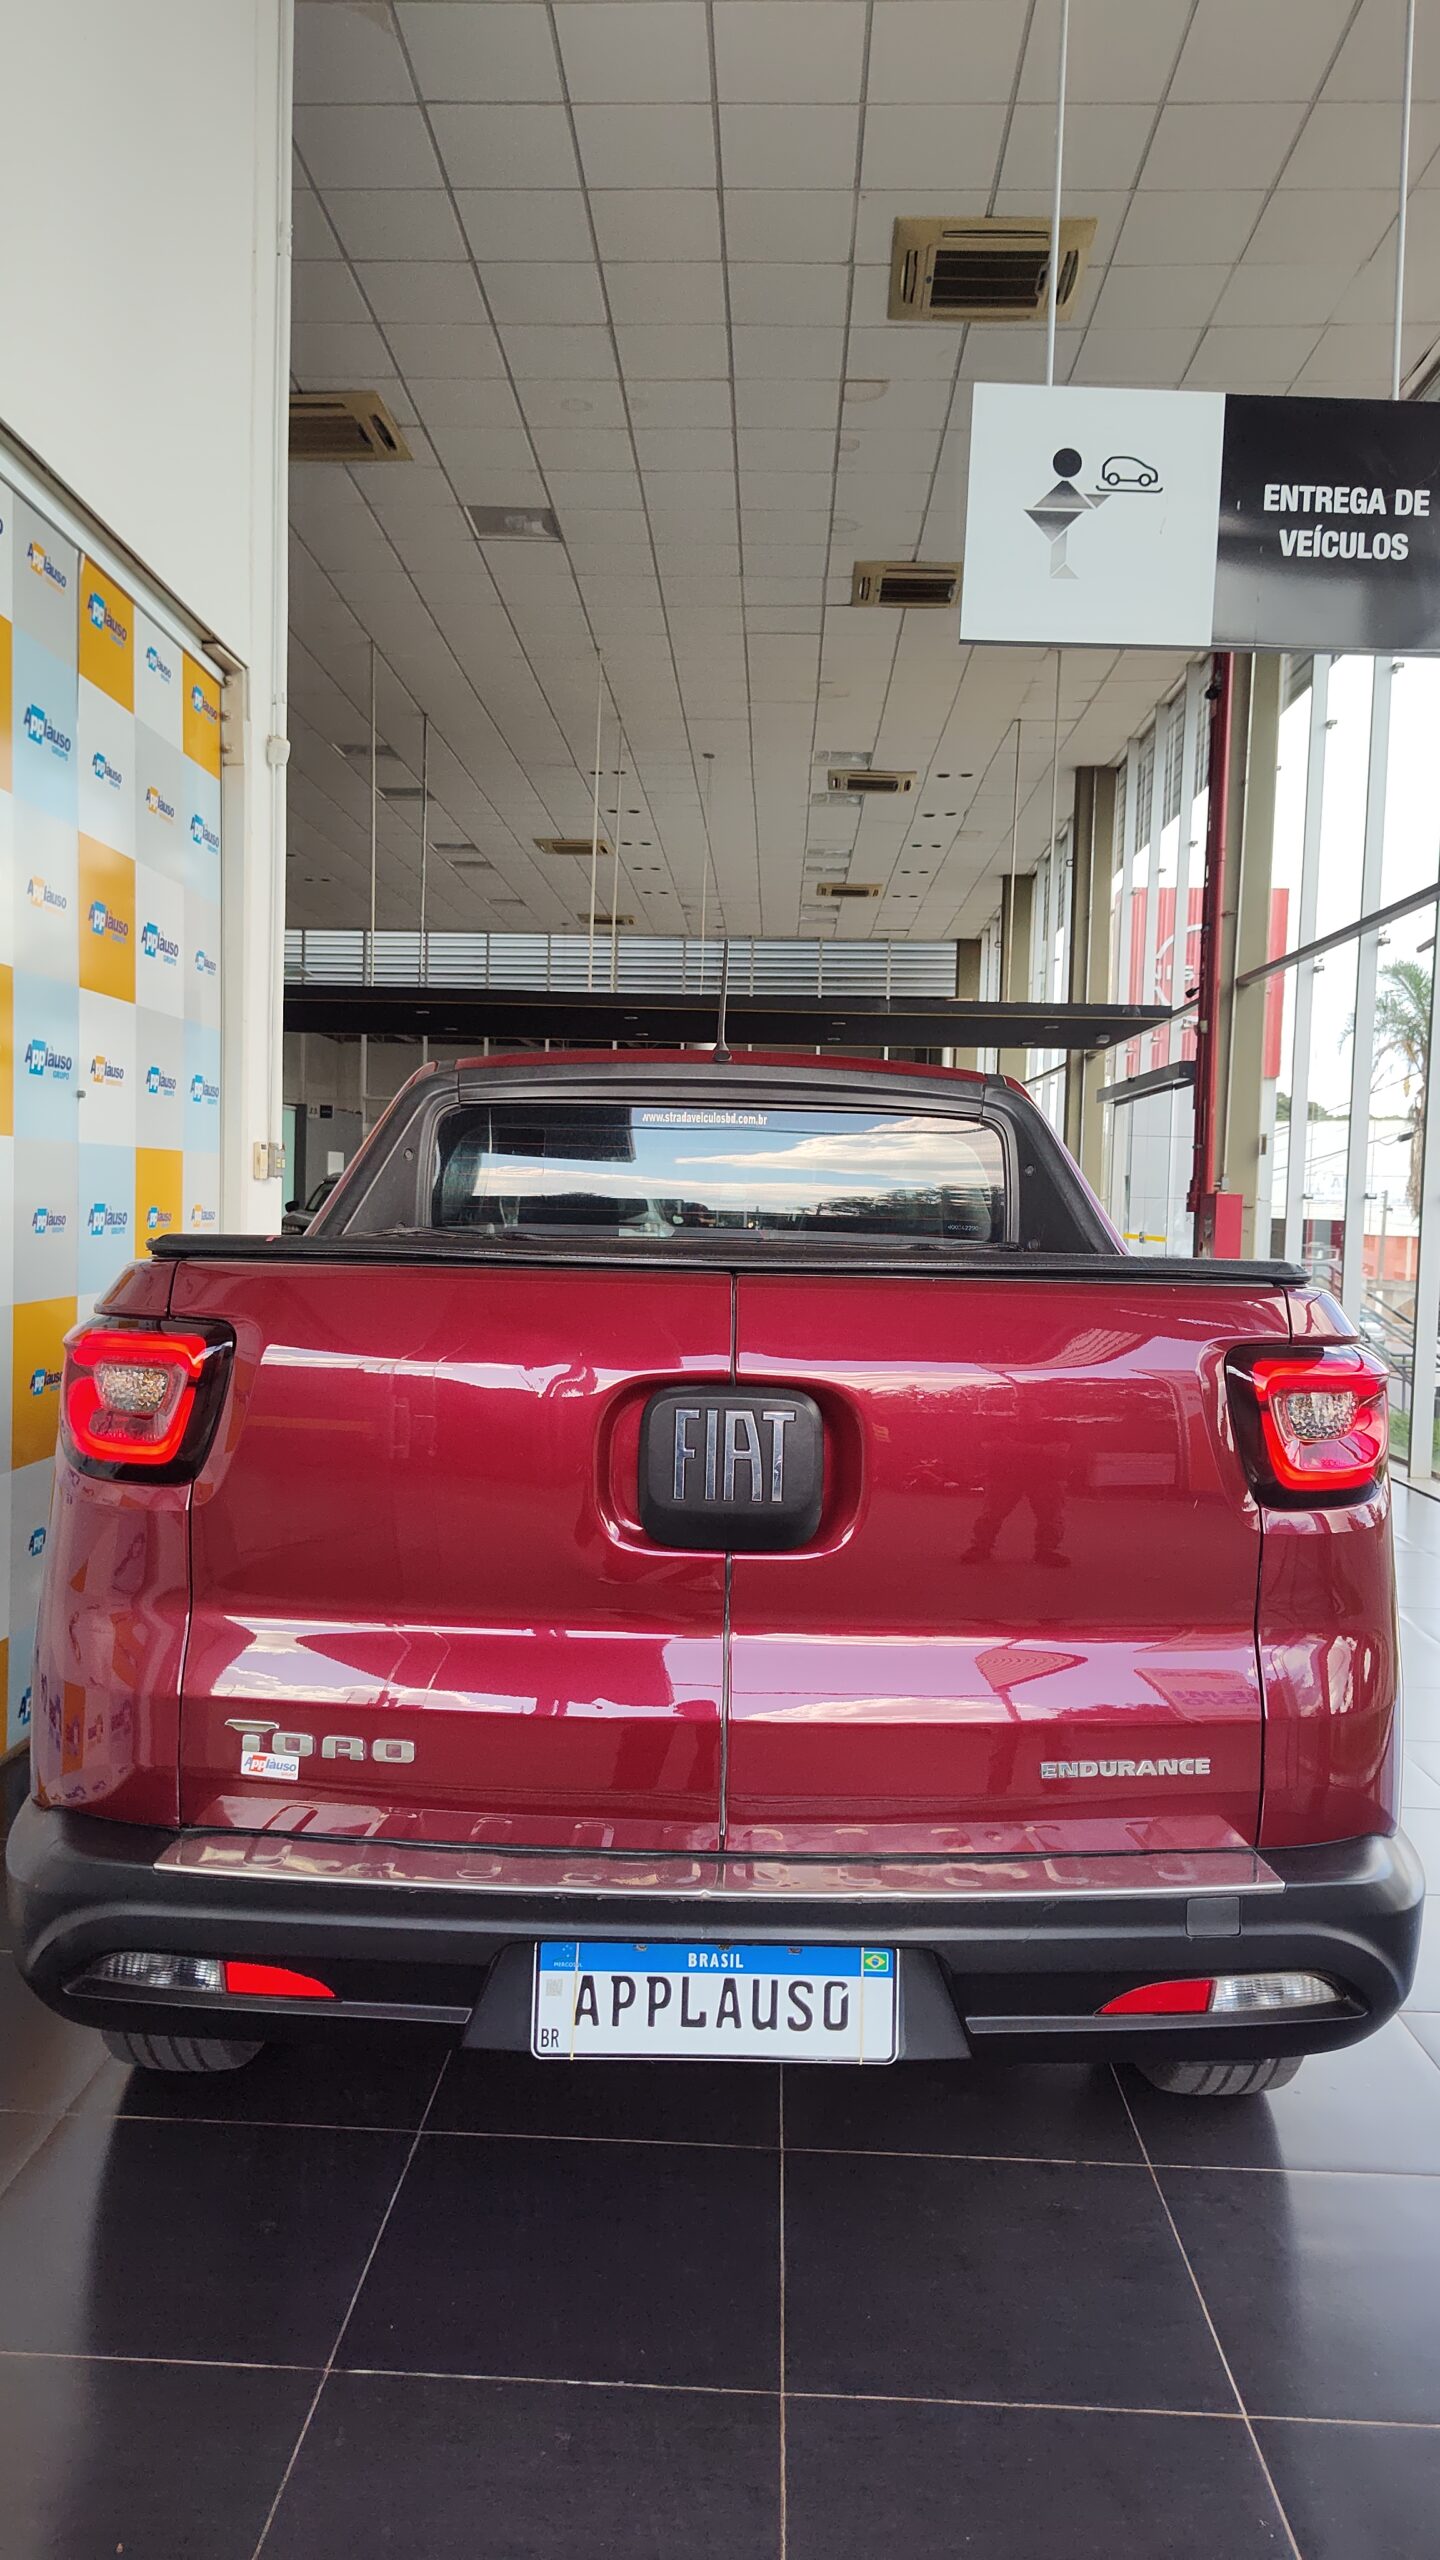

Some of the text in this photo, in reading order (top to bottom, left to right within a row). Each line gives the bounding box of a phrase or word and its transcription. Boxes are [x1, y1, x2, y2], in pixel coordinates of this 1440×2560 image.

[1263, 484, 1431, 517] ENTREGA DE
[1279, 525, 1409, 561] VEÍCULOS
[673, 1408, 796, 1502] FIAT
[224, 1718, 415, 1764] TORO
[1040, 1758, 1211, 1779] ENDURANCE
[687, 1952, 744, 1969] BRASIL
[574, 1974, 849, 2032] APPLAUSO
[540, 2027, 560, 2048] BR
